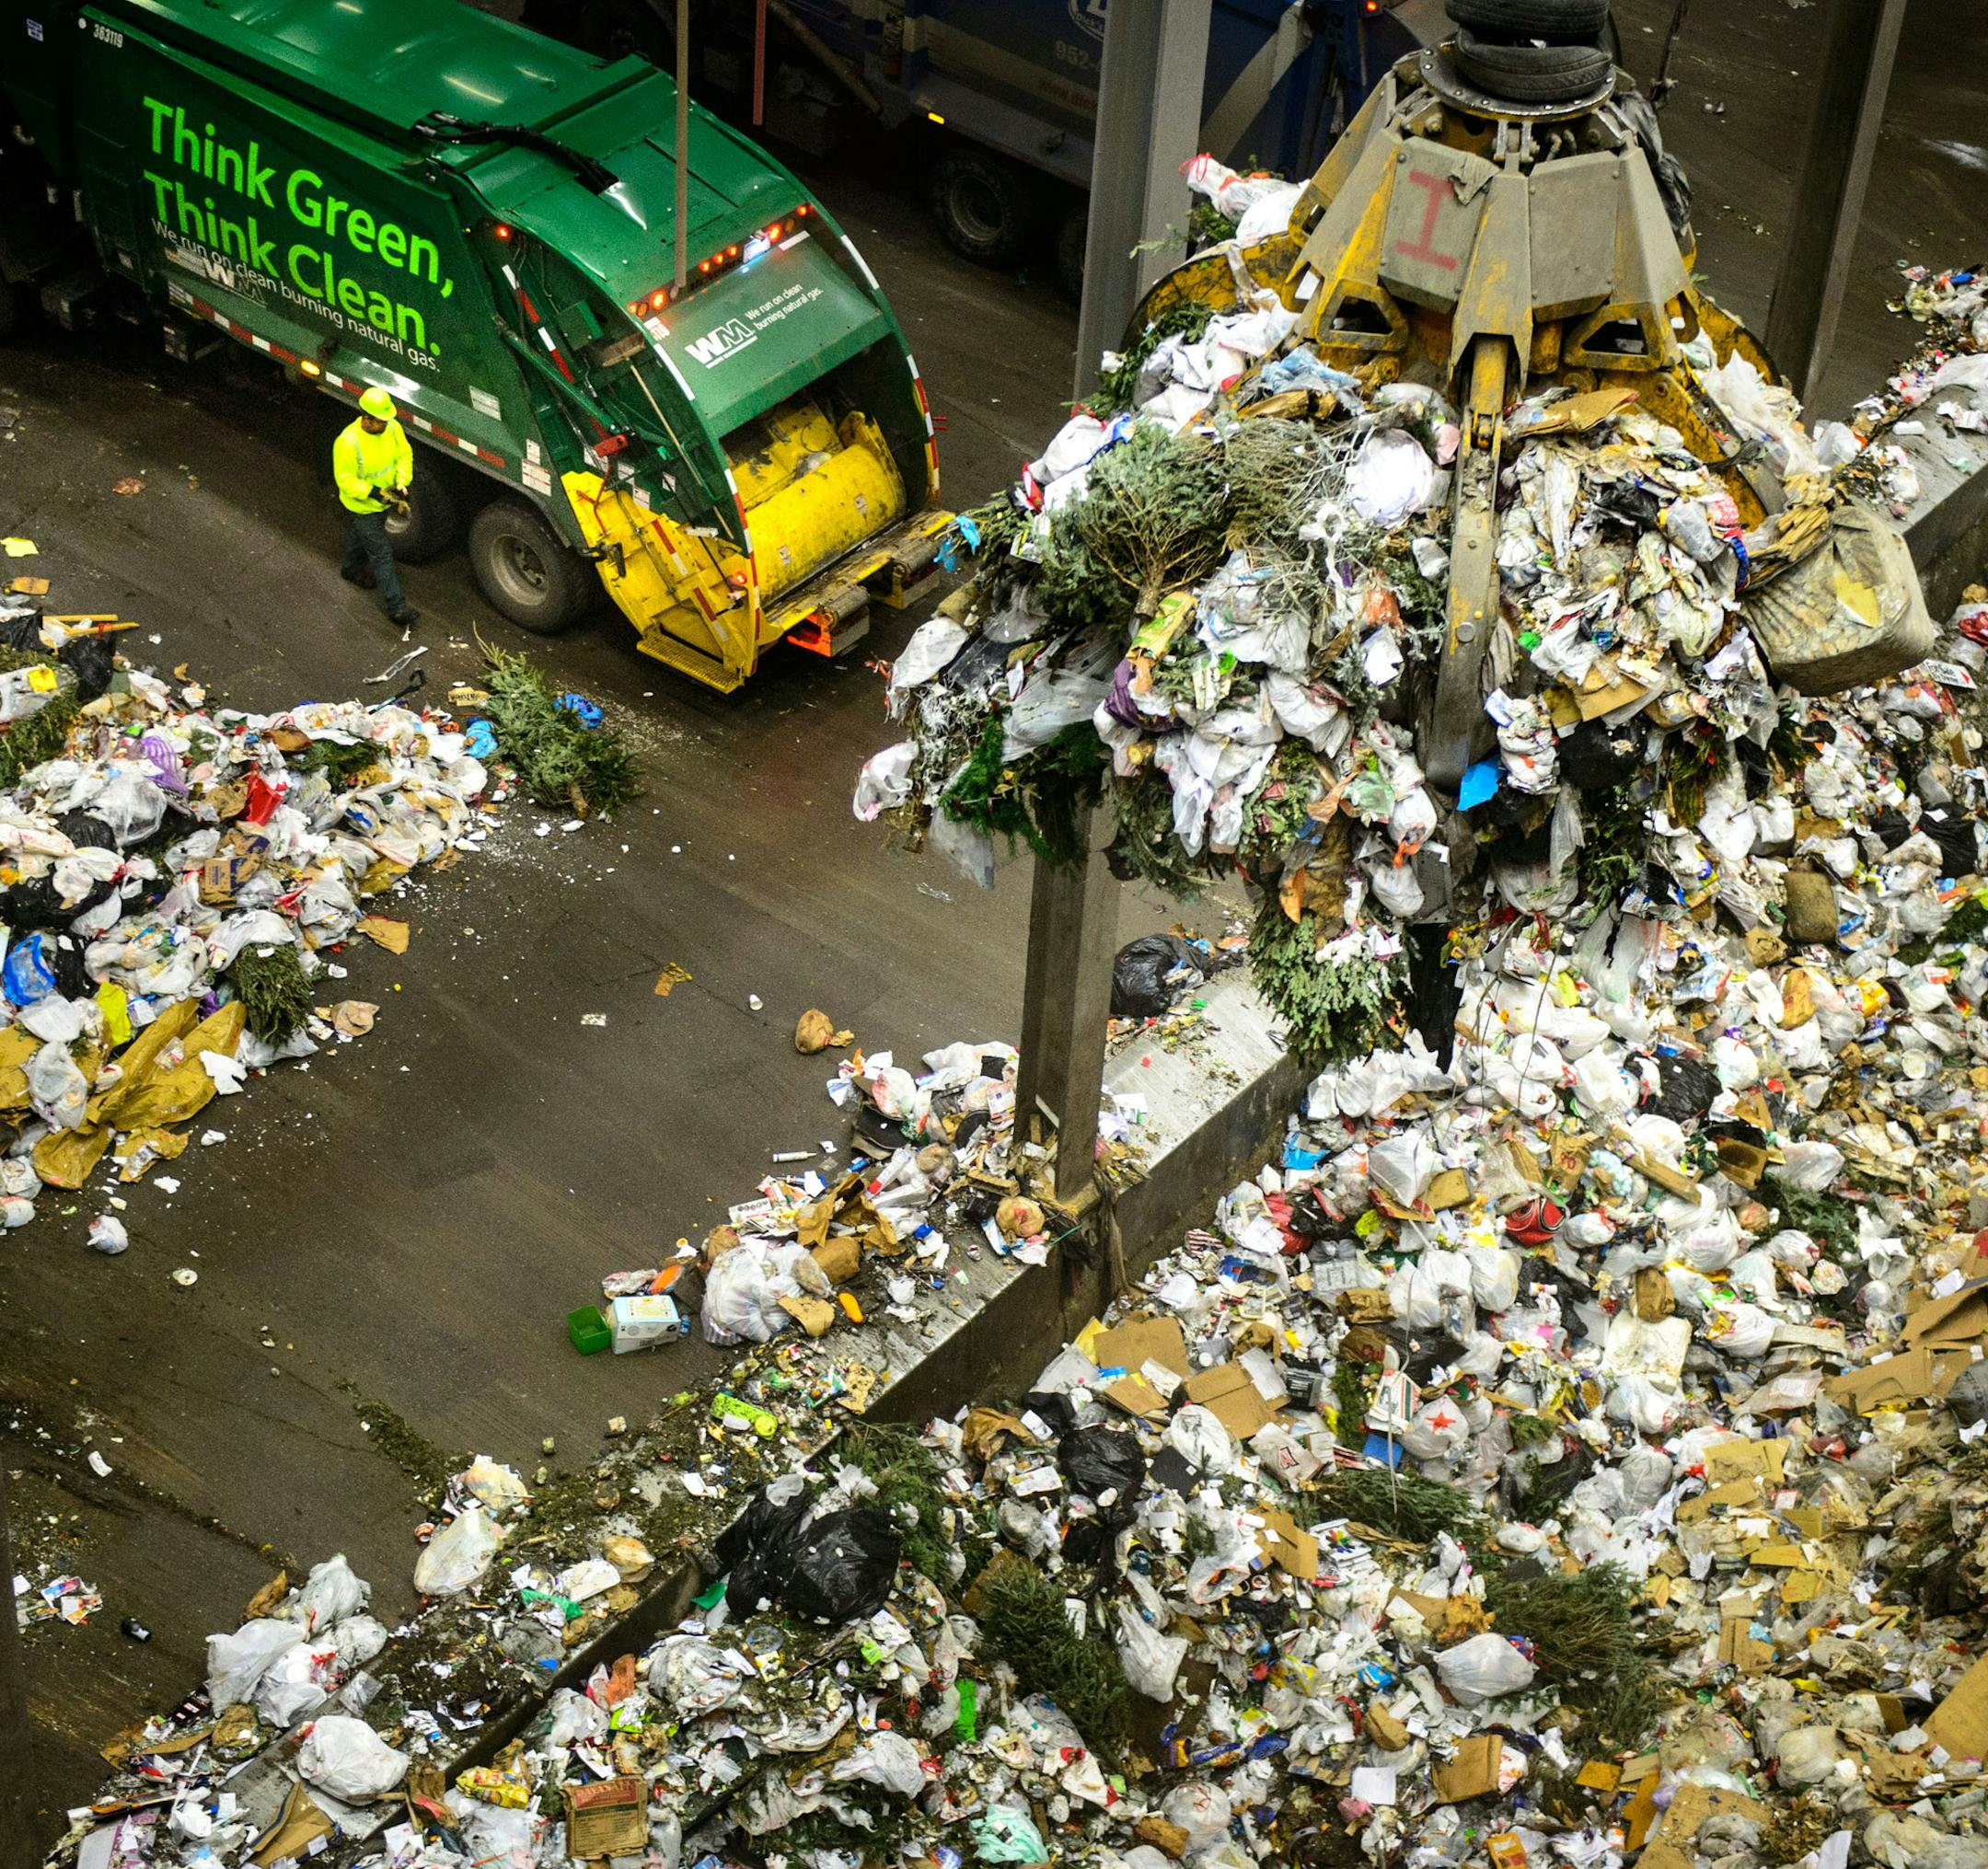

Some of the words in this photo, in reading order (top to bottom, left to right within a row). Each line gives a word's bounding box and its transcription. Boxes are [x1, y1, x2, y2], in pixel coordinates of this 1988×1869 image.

[93, 23, 124, 49] 363119
[144, 96, 276, 209] Think
[287, 169, 454, 299] Green,
[144, 169, 280, 278] Think
[288, 244, 441, 357] Clean.
[202, 257, 267, 306] WM
[151, 218, 178, 242] We
[180, 237, 208, 259] run
[212, 250, 233, 271] on
[236, 262, 278, 293] clean
[280, 280, 344, 329] burning
[348, 318, 403, 355] natural
[408, 348, 441, 372] gas.
[745, 309, 761, 320] We
[759, 301, 775, 314] run
[772, 294, 785, 306] on
[782, 283, 803, 299] clean
[753, 310, 786, 330] burning
[782, 293, 809, 314] natural
[807, 287, 824, 302] gas.
[685, 318, 756, 364] WM
